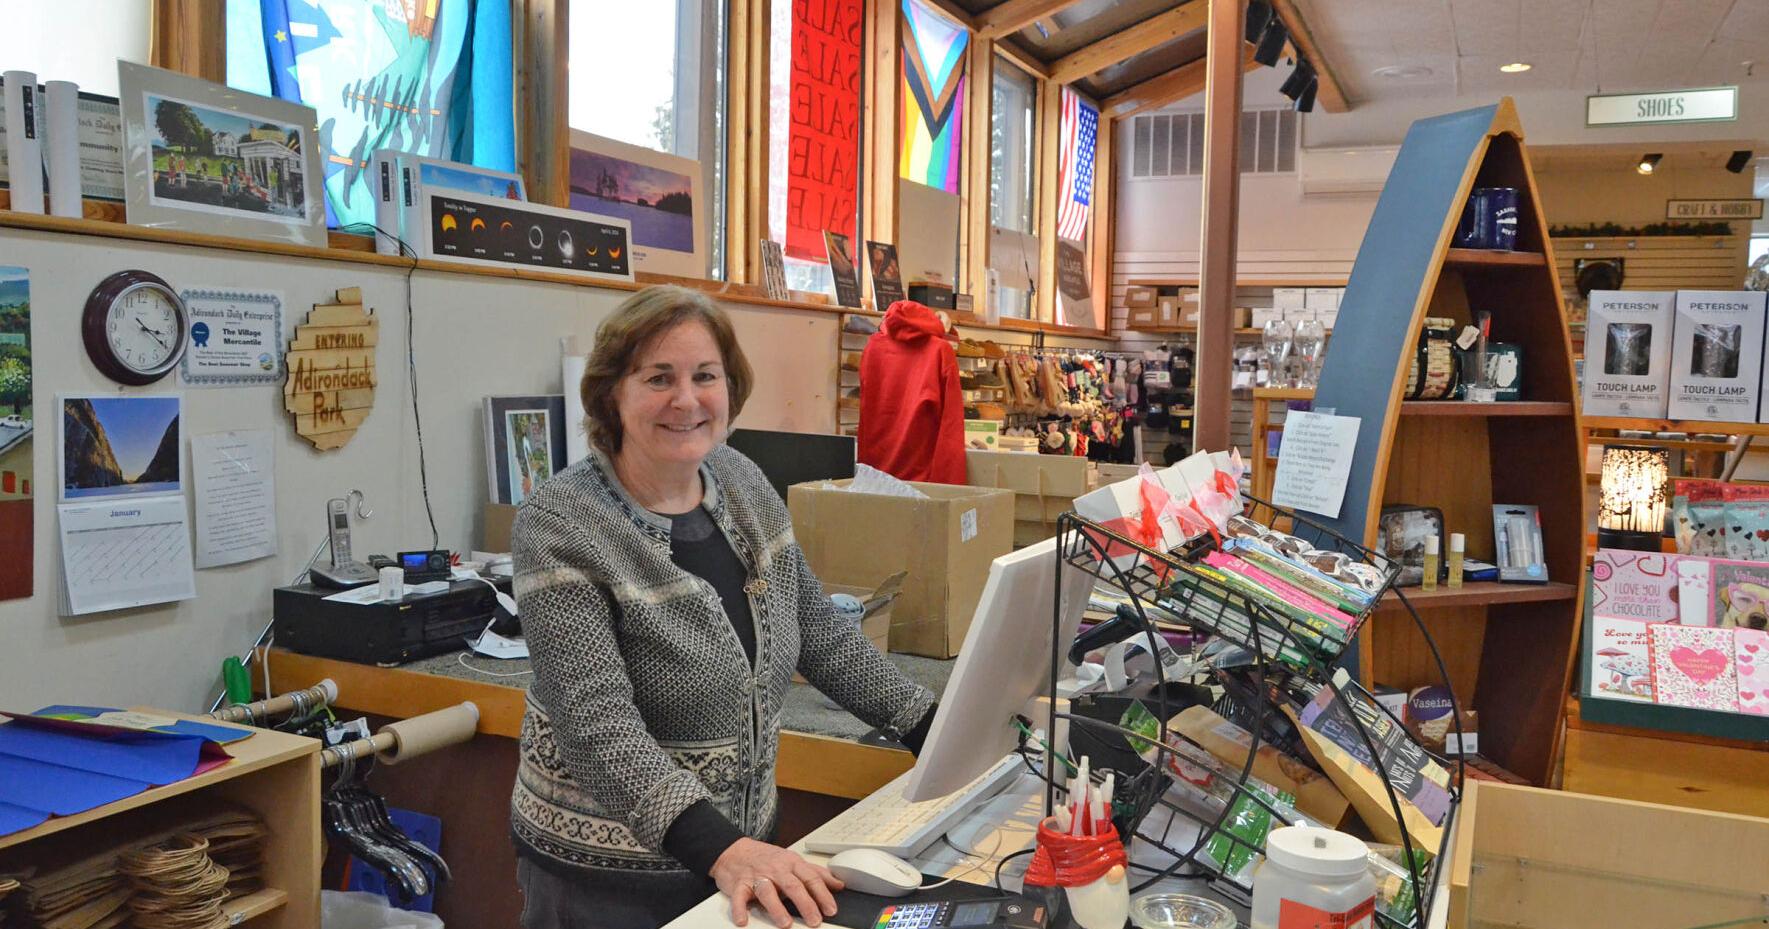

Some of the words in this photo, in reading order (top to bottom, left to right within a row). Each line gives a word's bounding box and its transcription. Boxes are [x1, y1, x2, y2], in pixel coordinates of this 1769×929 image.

[1637, 97, 1685, 118] SHOES
[1676, 203, 1705, 216] CRAFT
[1709, 203, 1718, 216] &
[125, 296, 133, 308] 11
[137, 289, 148, 304] 12
[1603, 302, 1660, 311] PETERSON
[1690, 302, 1749, 311] PETERSON
[115, 307, 125, 319] 10
[164, 310, 170, 321] 2
[111, 322, 117, 332] 9
[237, 329, 262, 338] Village
[224, 338, 262, 346] Mercantile
[315, 333, 364, 350] ENTERING
[125, 348, 132, 359] 7
[139, 353, 145, 364] 6
[153, 349, 159, 360] 5
[292, 355, 373, 398] Adirondack
[1597, 382, 1628, 392] TOUCH
[1630, 384, 1657, 393] LAMP
[1683, 385, 1716, 395] TOUCH
[1718, 386, 1746, 396] LAMP
[313, 391, 346, 428] Park
[110, 510, 141, 519] January
[1619, 582, 1640, 595] LOVE
[1642, 583, 1661, 596] YOU
[1612, 602, 1662, 617] CHOCOLATE
[1604, 629, 1633, 637] Love
[1635, 632, 1648, 640] yo
